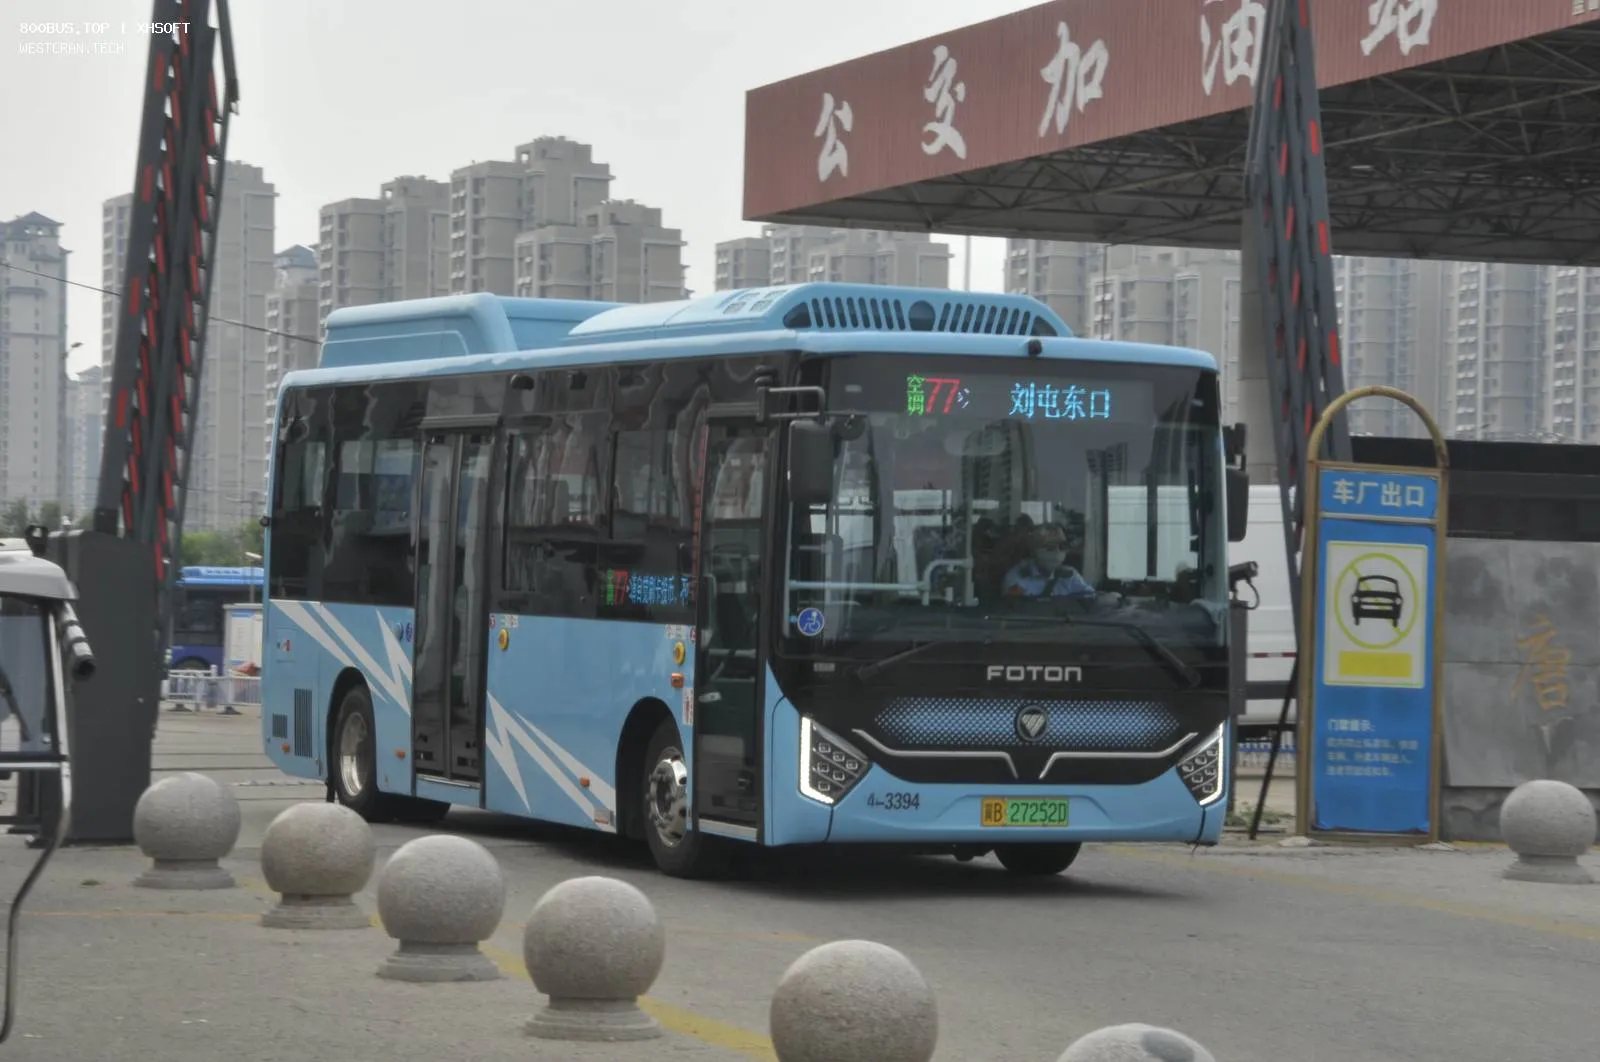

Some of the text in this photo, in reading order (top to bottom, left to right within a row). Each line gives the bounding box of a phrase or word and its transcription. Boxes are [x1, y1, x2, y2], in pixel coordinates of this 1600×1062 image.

[906, 375, 960, 416] 空调 77
[1009, 382, 1110, 420] 刘屯东口
[1332, 479, 1424, 507] 车厂出口
[987, 665, 1082, 681] FOTON
[1010, 802, 1067, 823] 27252D
